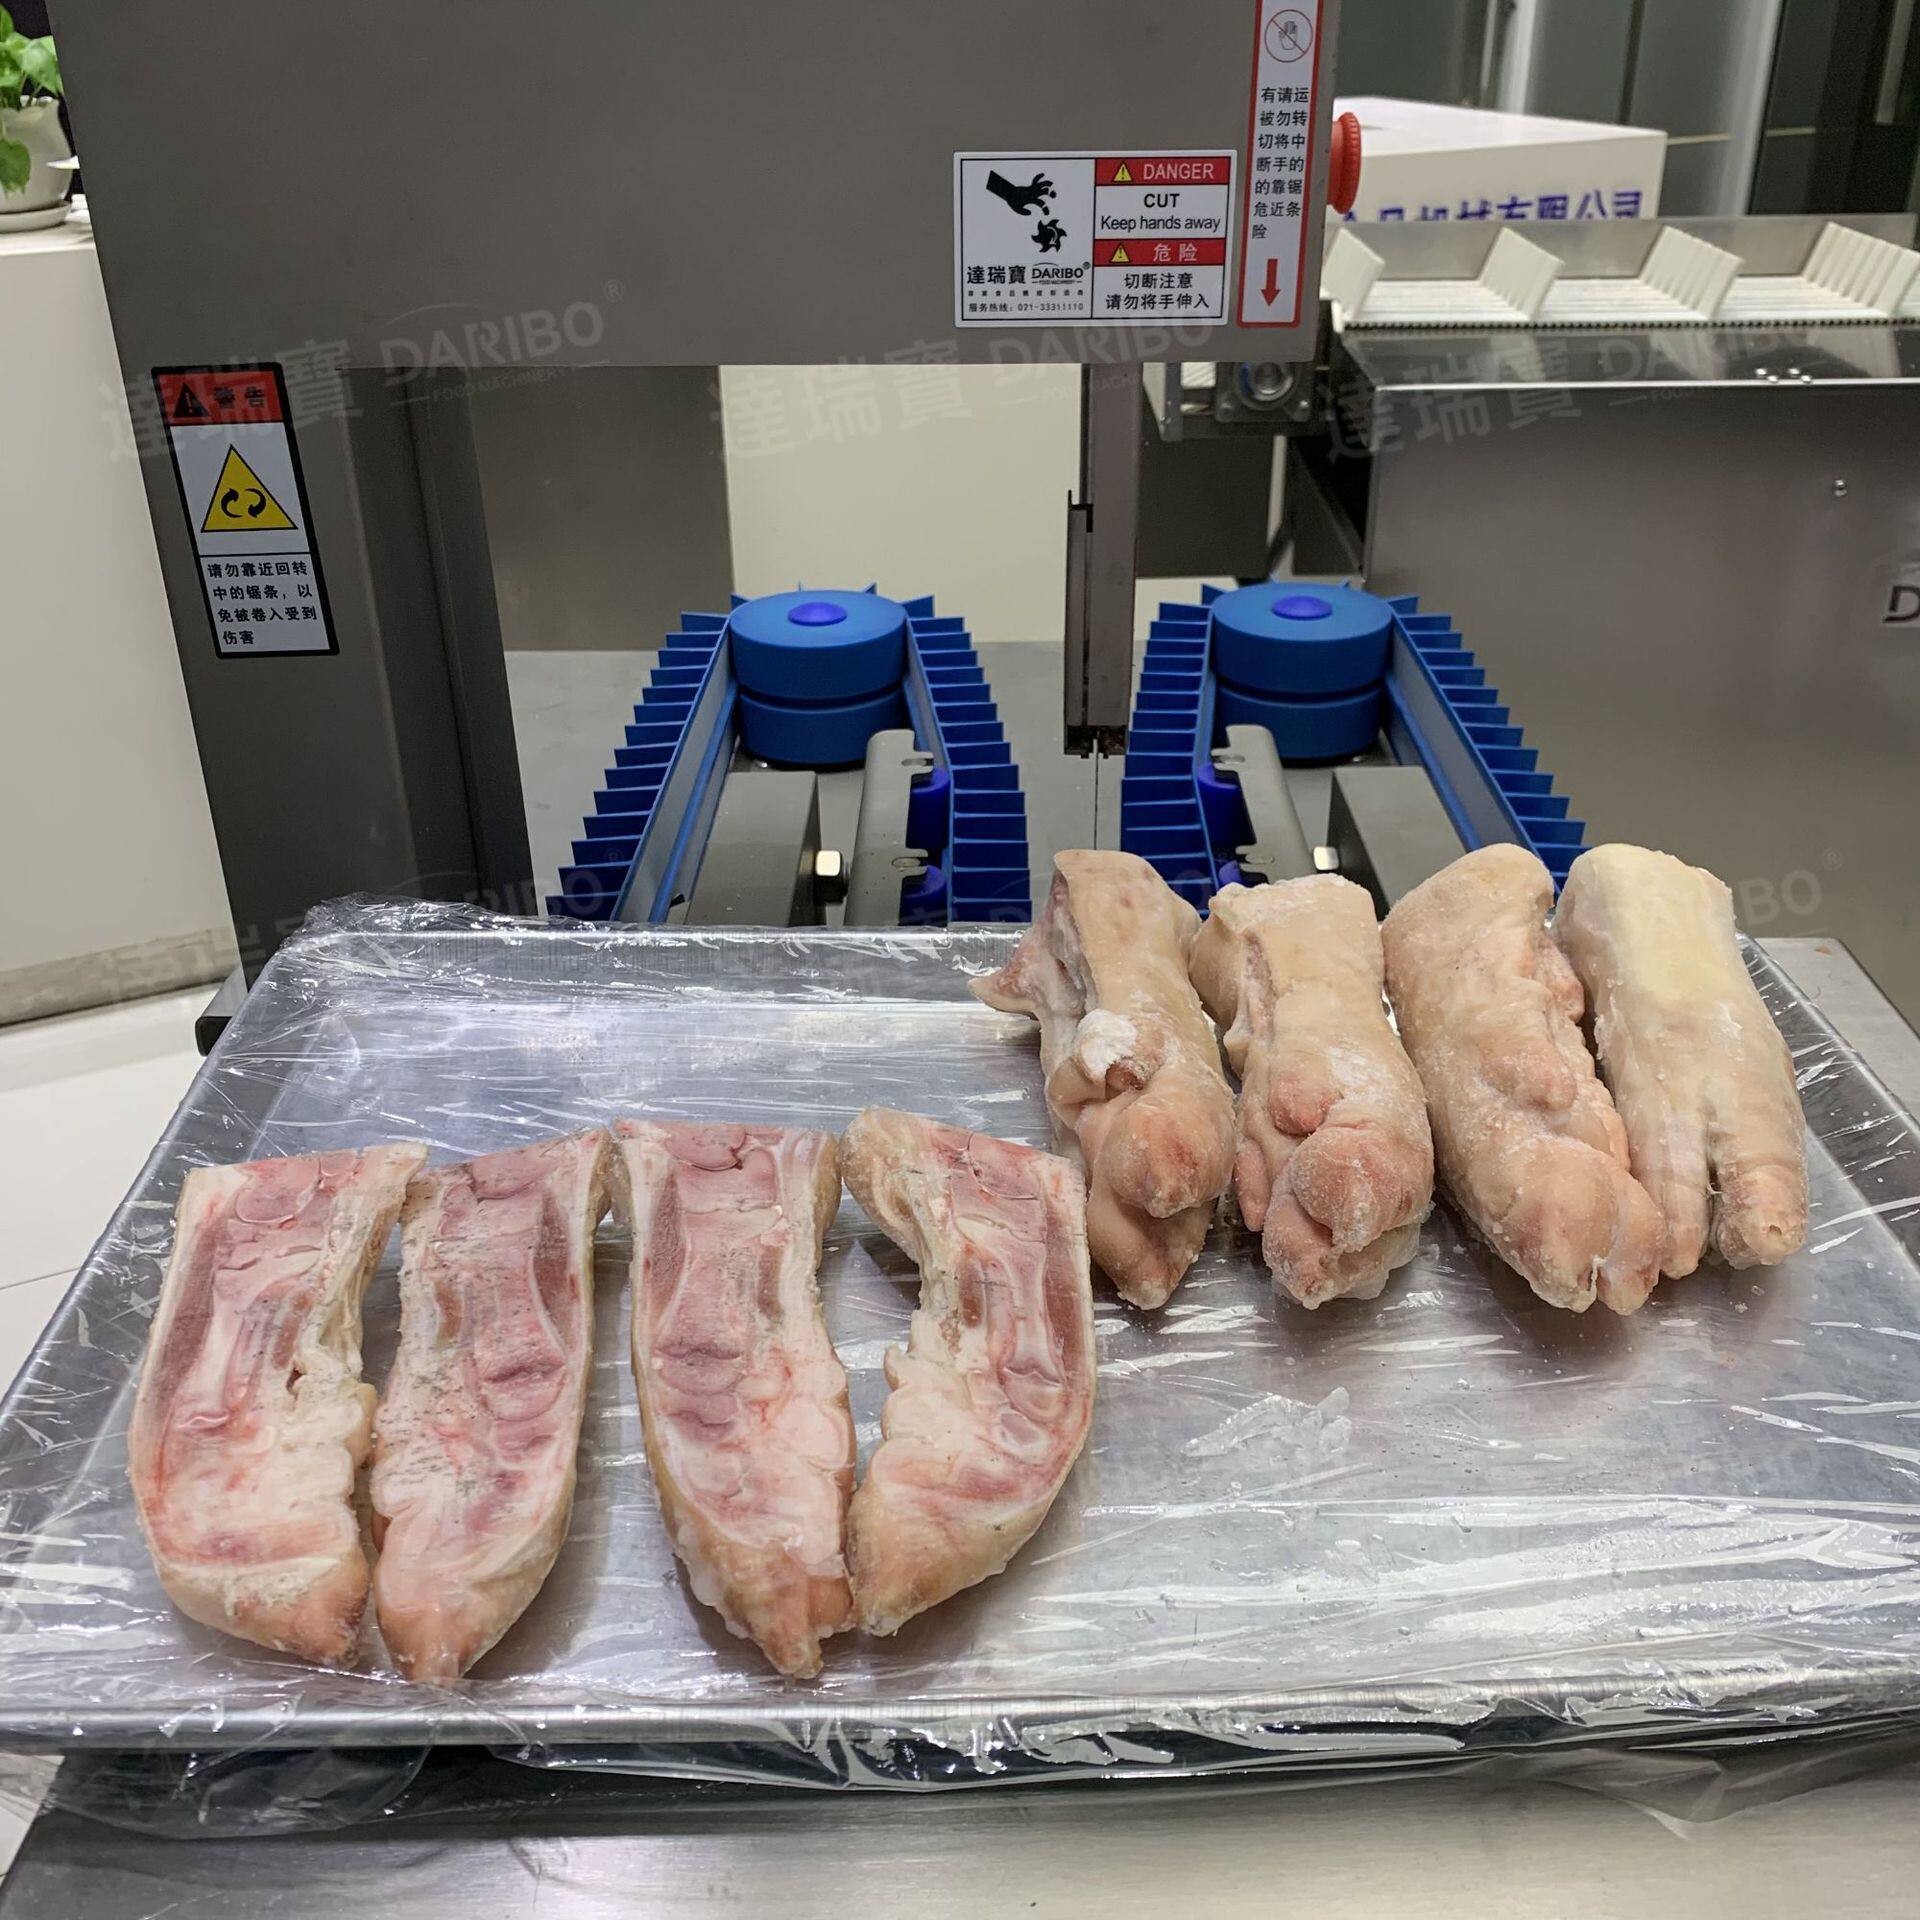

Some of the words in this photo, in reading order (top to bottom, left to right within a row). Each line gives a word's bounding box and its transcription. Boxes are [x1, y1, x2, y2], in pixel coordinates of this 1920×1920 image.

[1143, 163, 1215, 180] DANGER
[1143, 193, 1180, 208] CUT
[1101, 216, 1136, 233] Keep
[1140, 215, 1181, 230] hands
[1184, 218, 1221, 233] away
[1153, 243, 1198, 262] 危险
[967, 265, 1026, 285] 達瑞寶
[1031, 267, 1084, 279] DARIBO
[1124, 272, 1194, 289] 切断注意
[1106, 293, 1210, 310] 请勿将手伸入
[213, 386, 266, 409] 警告
[207, 561, 308, 579] 请勿靠近回转
[217, 604, 318, 624] 免被卷入受到
[222, 629, 255, 646] 伤害
